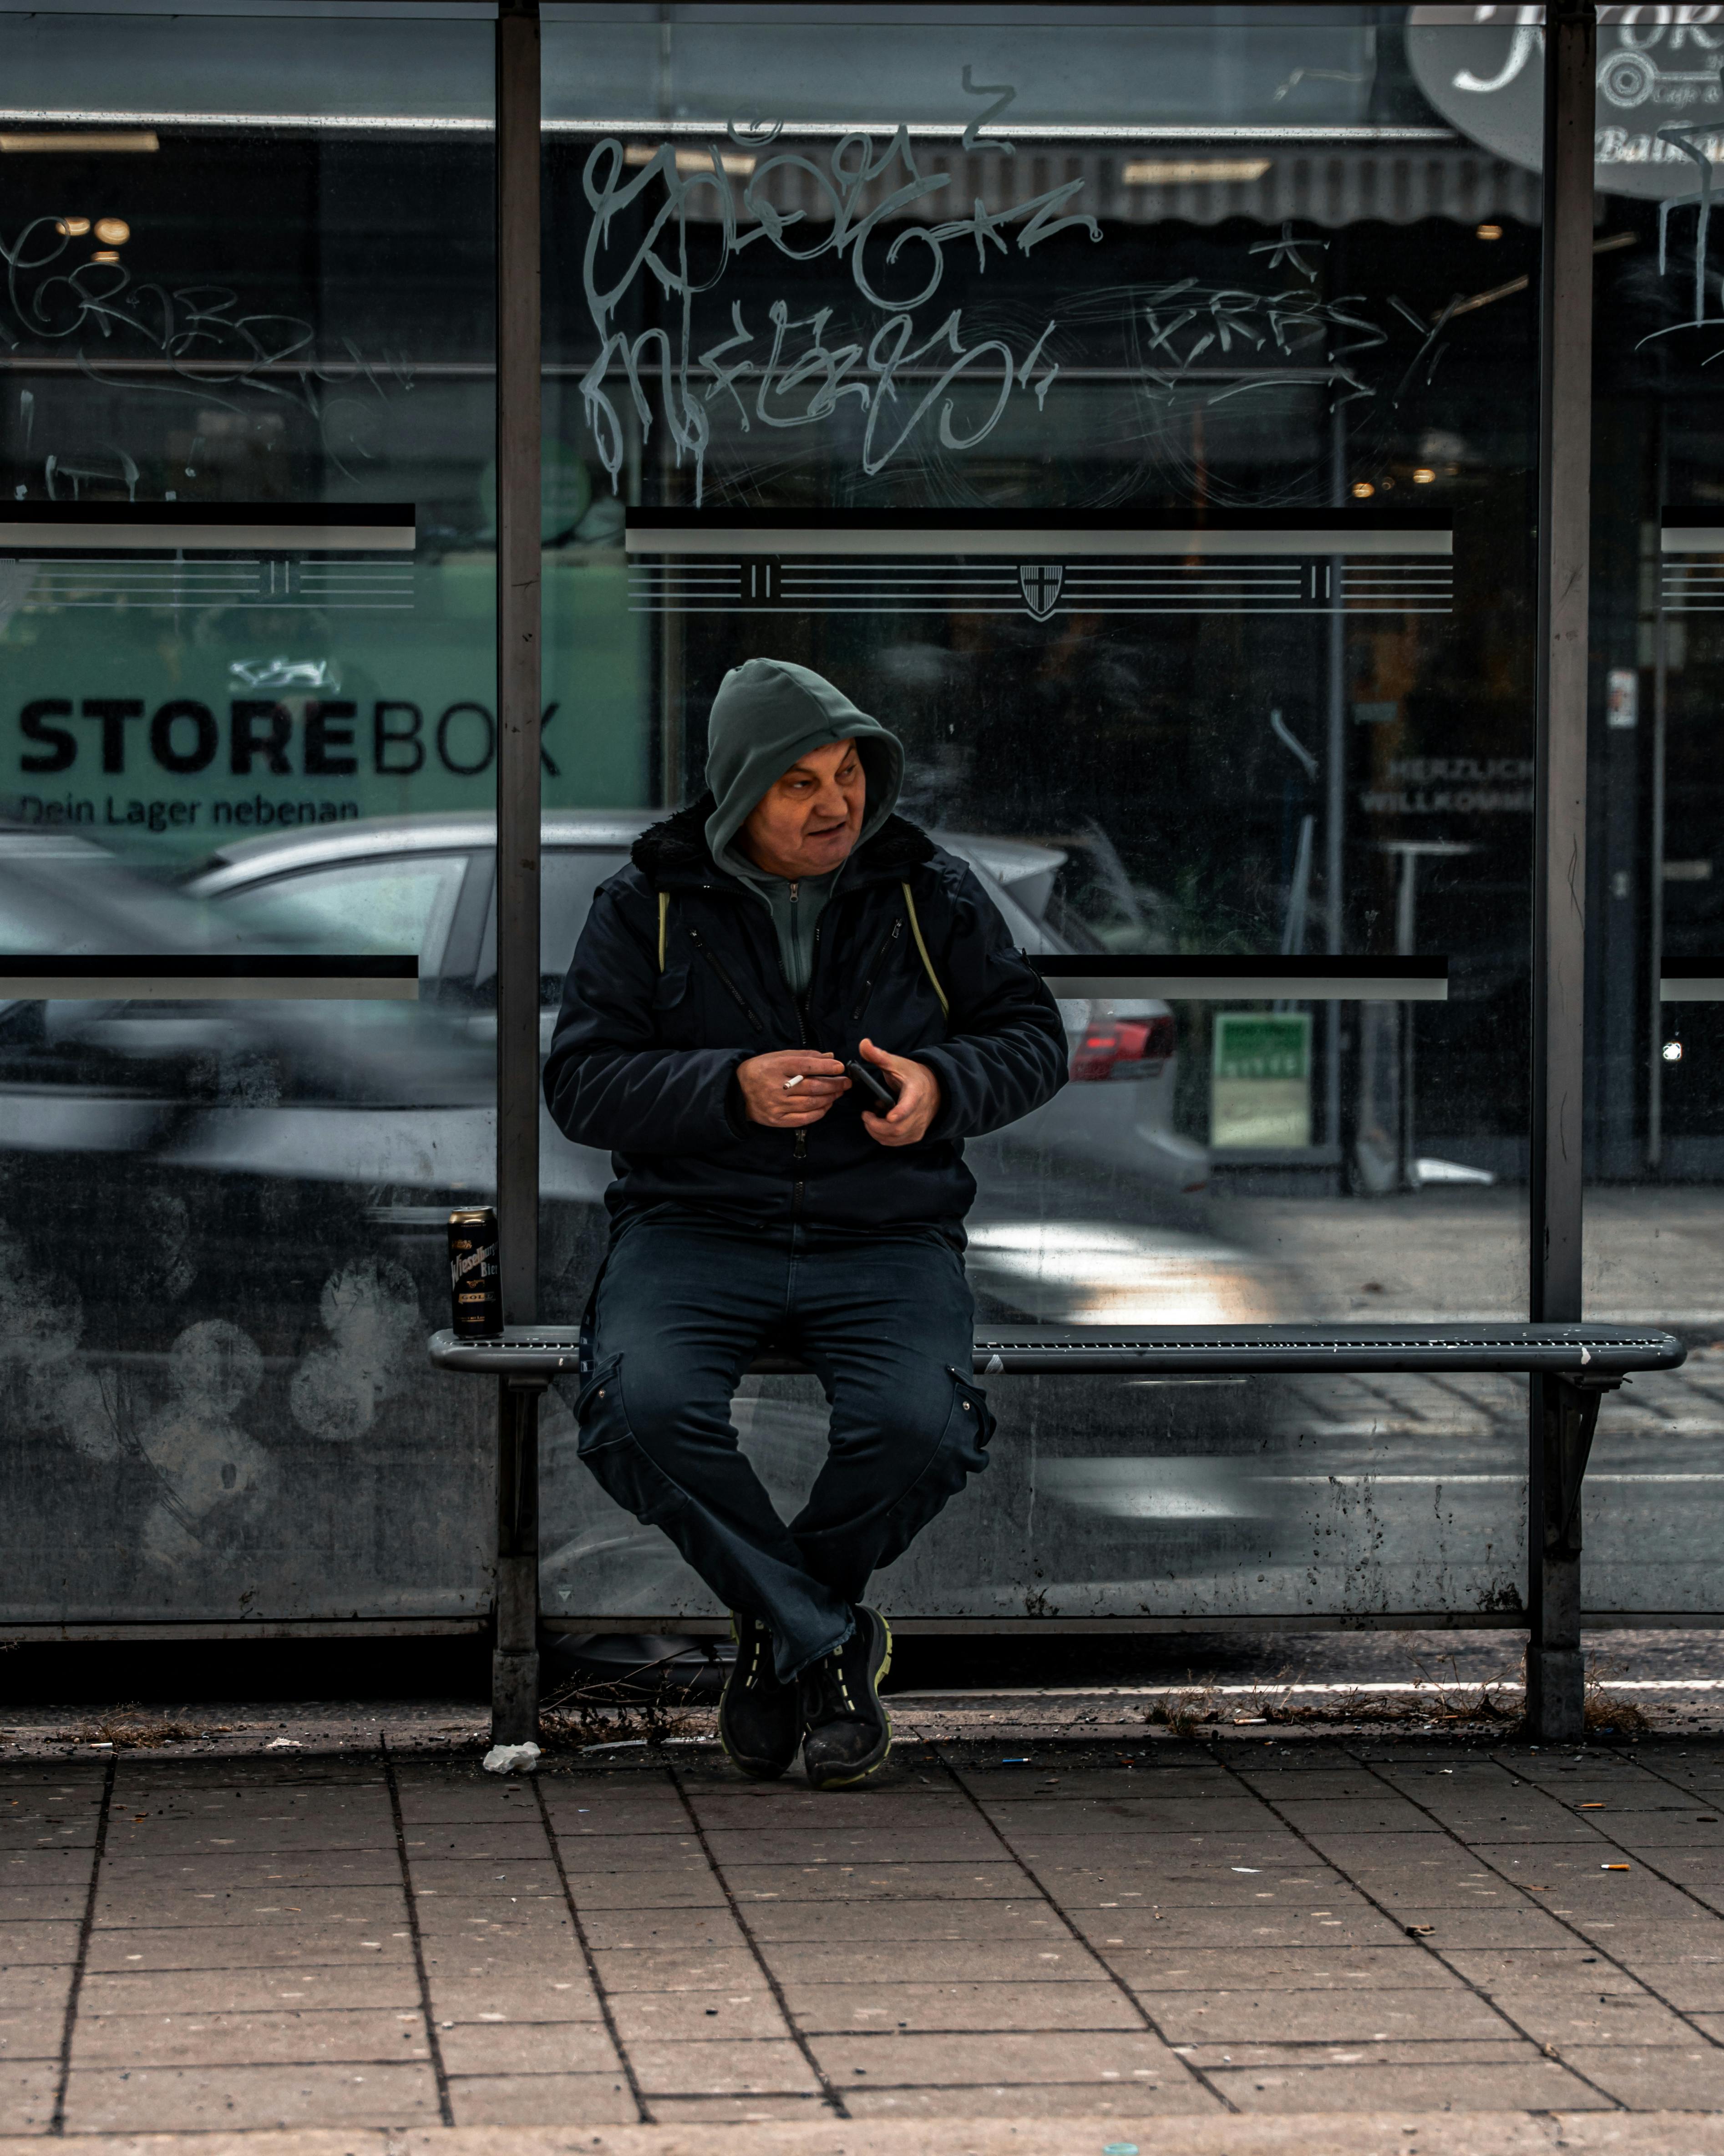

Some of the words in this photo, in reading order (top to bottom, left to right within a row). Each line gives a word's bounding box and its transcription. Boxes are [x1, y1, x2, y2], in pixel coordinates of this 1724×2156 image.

[22, 793, 95, 824] Dein
[107, 796, 200, 832] Lager
[214, 794, 359, 824] nebenan
